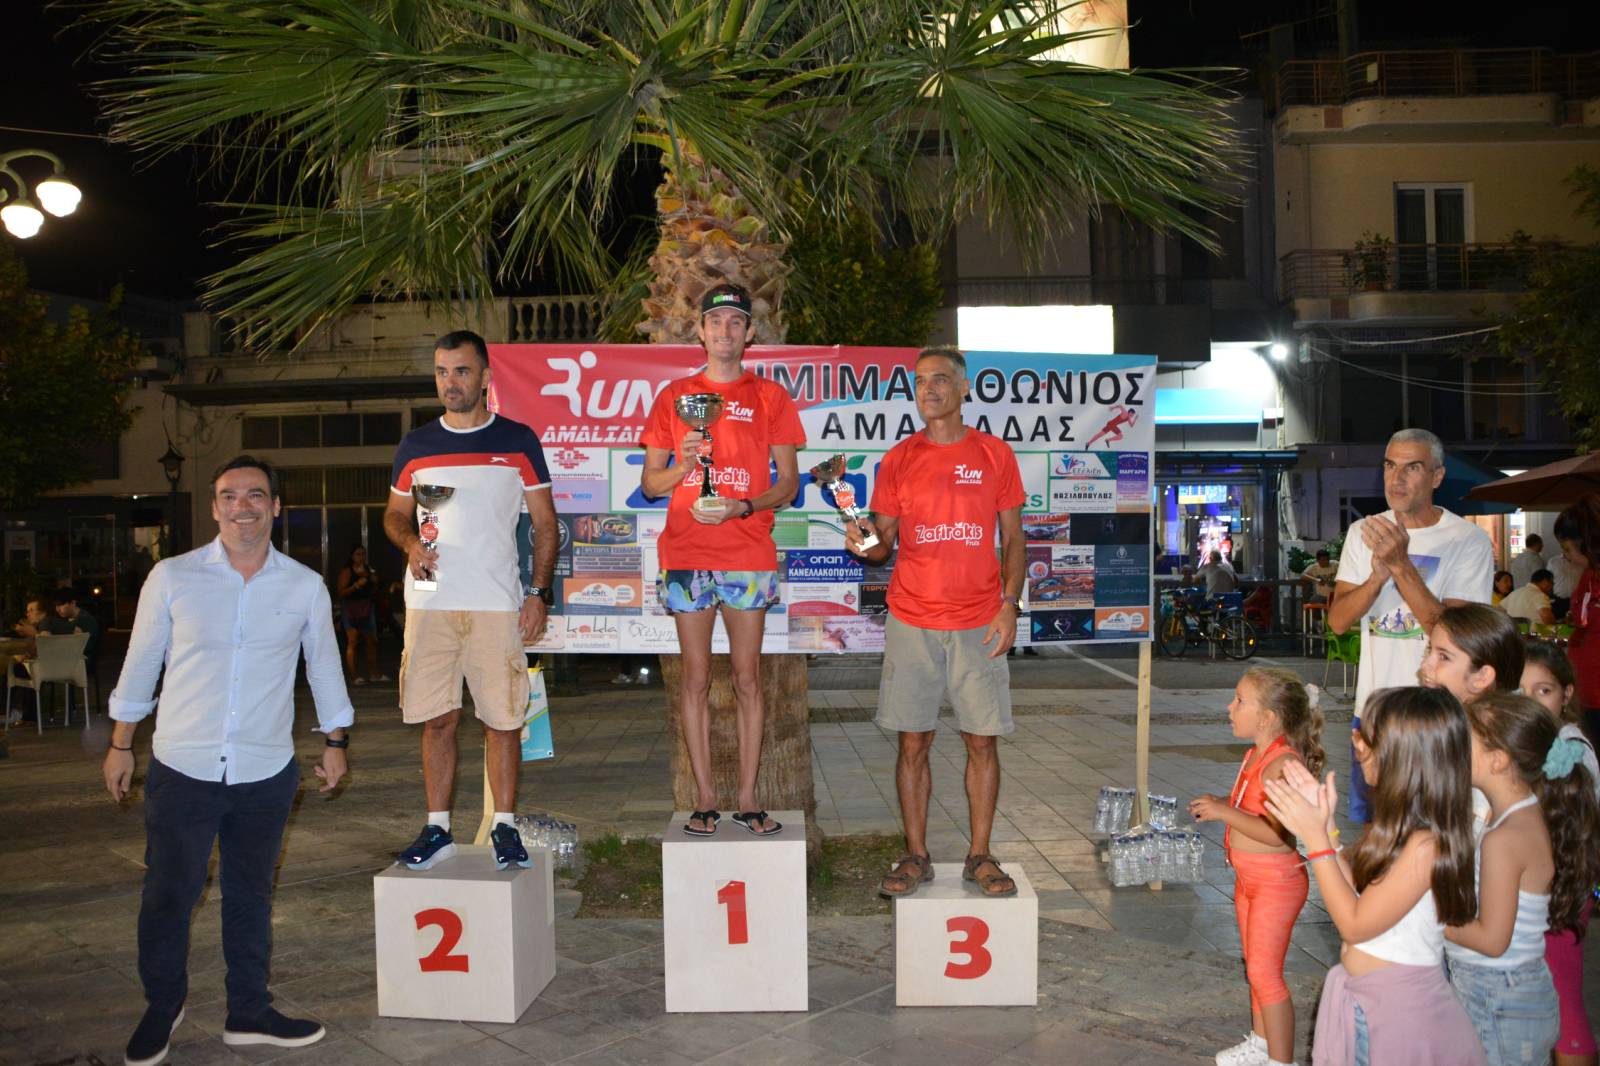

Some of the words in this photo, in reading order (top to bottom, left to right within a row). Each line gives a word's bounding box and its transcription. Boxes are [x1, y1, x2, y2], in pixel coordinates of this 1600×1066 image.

[540, 350, 672, 419] RUN
[725, 401, 755, 417] RUN
[954, 463, 983, 480] RUN
[788, 567, 863, 577] ΚΑΝΕΛΛΑΚΟΠΟΥΛΟΣ
[414, 908, 469, 973] 2
[717, 880, 749, 945] 1
[944, 916, 993, 980] 3
